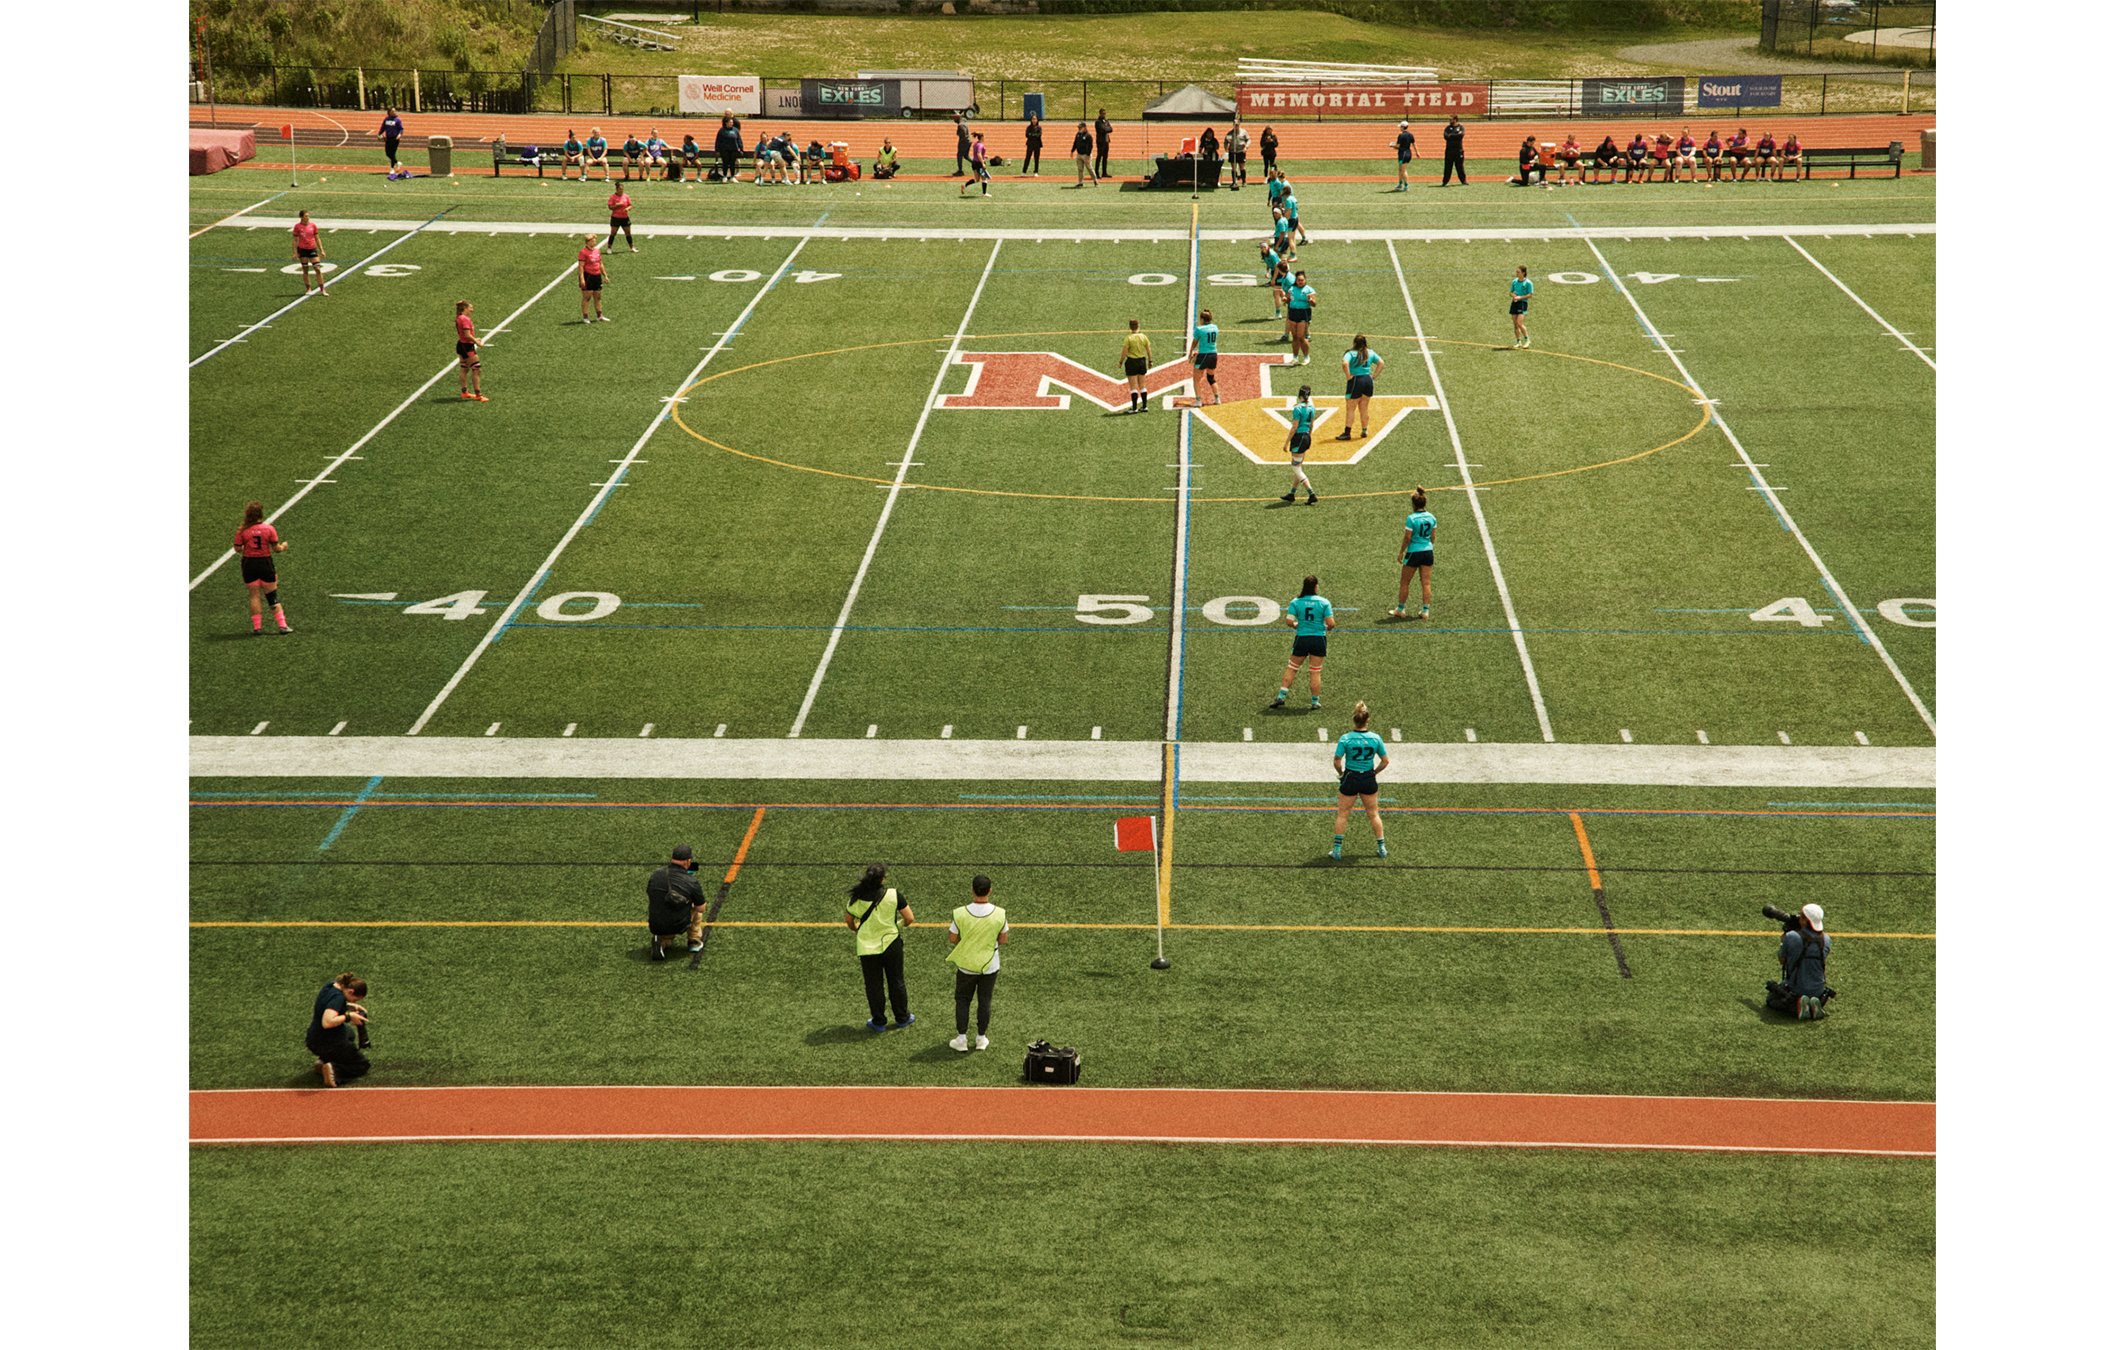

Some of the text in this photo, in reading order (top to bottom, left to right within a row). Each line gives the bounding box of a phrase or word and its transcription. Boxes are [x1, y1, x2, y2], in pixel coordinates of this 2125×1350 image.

[702, 84, 754, 93] Weill Cornell
[821, 87, 881, 103] EXILES
[1602, 87, 1665, 102] EXILES
[1703, 82, 1741, 96] Stout
[703, 93, 742, 101] Medicine
[1250, 92, 1474, 107] MEMORIAL FIELD
[1207, 332, 1216, 343] 10
[1419, 521, 1431, 537] 12
[252, 535, 262, 550] 3
[1305, 607, 1315, 621] 6
[1352, 746, 1374, 761] 22
